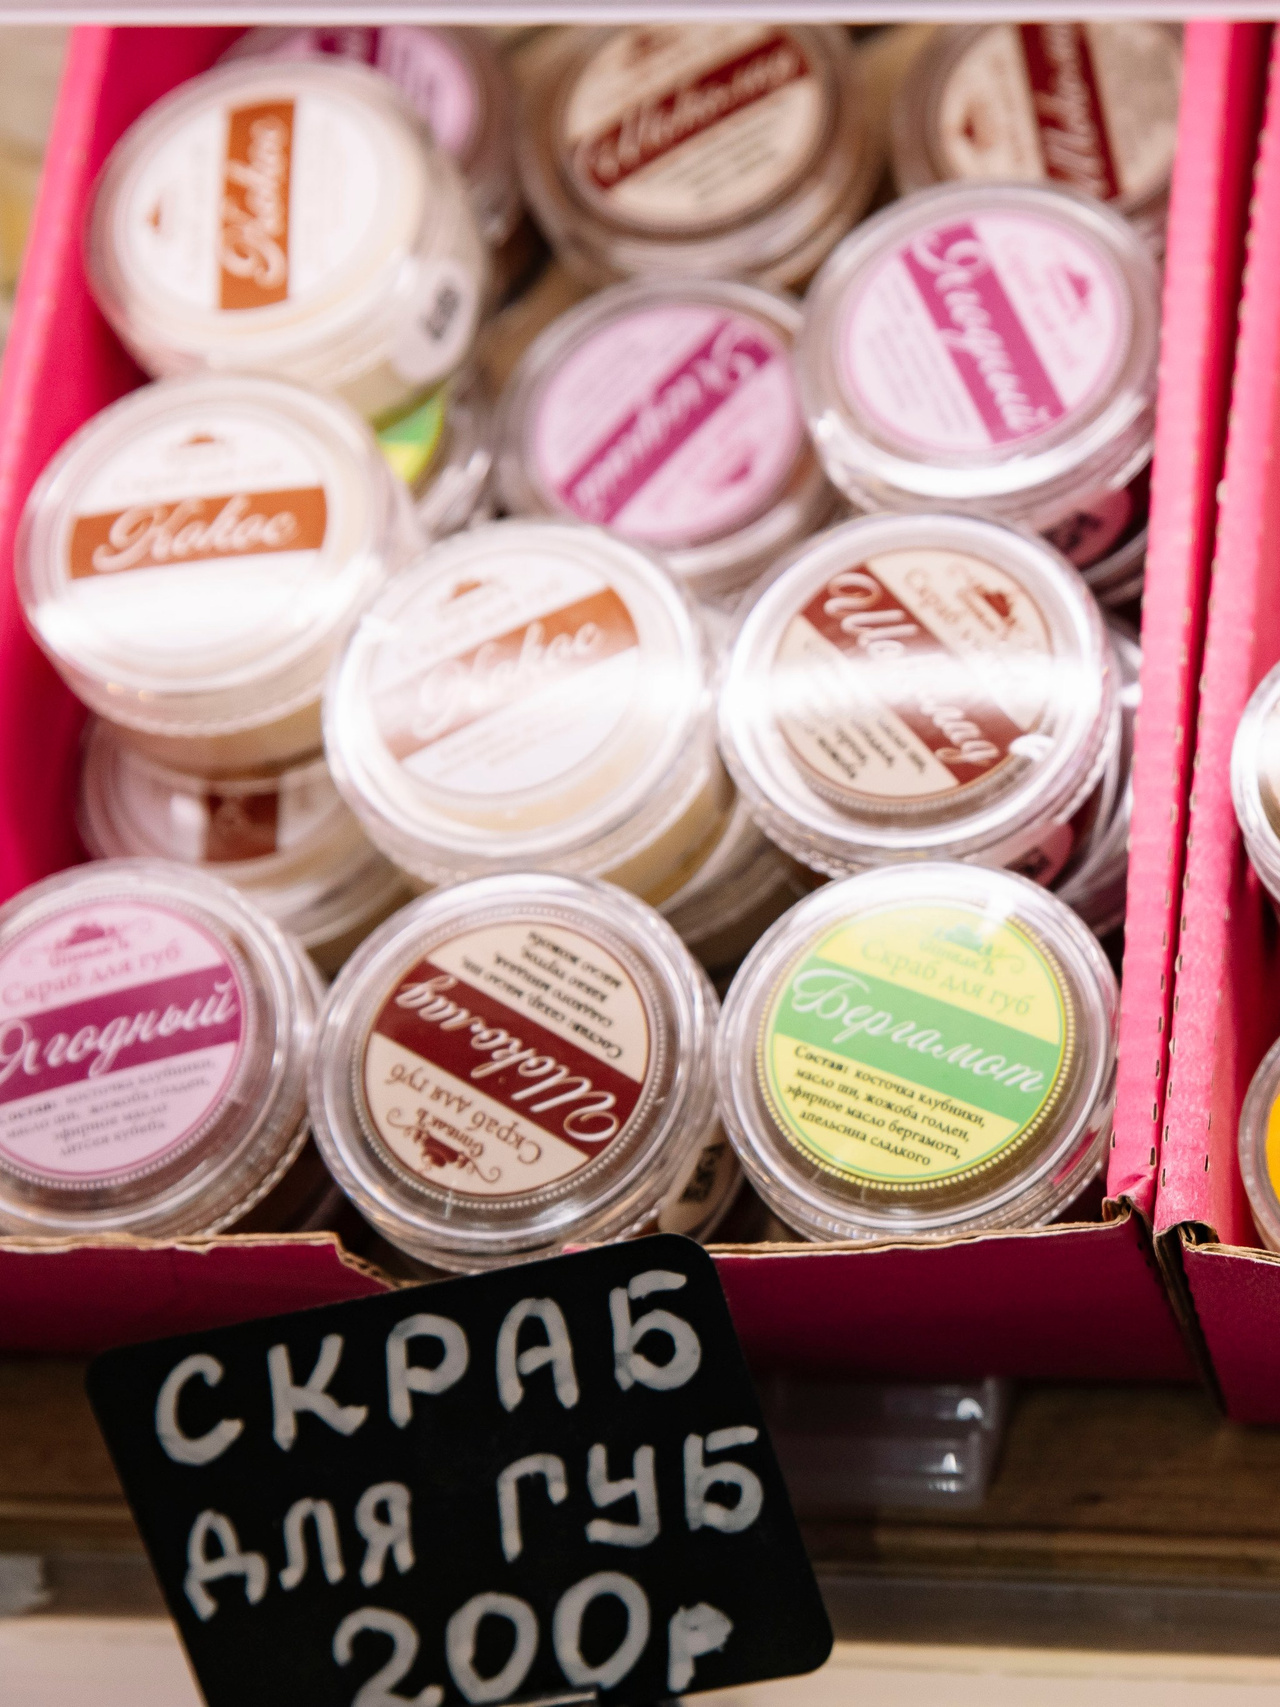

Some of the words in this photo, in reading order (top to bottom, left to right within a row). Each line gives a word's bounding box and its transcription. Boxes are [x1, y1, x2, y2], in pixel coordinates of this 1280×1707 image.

[92, 494, 298, 573] Кокос
[861, 939, 938, 981] Скраб
[939, 977, 983, 999] для
[989, 989, 1035, 1016] губ
[0, 977, 239, 1086] Ягодный
[395, 974, 619, 1142] Шоколад
[791, 968, 1045, 1093] Бергамот
[385, 1063, 428, 1093] губ
[432, 1086, 471, 1113] для
[796, 1068, 834, 1091] масло
[865, 1090, 918, 1122] жожоба
[921, 1114, 970, 1142] голден,
[854, 1062, 916, 1099] косточка
[919, 1090, 986, 1128] клубники,
[472, 1110, 542, 1164] Скраб
[787, 1082, 842, 1116] эфирное
[845, 1106, 885, 1128] масло
[888, 1118, 960, 1160] бергамота,
[799, 1111, 868, 1144] апельсина
[870, 1136, 930, 1166] сладкого
[154, 1269, 702, 1466] СКРАБ
[182, 1481, 415, 1621] ДЛЯ
[497, 1425, 764, 1562] ГУБ
